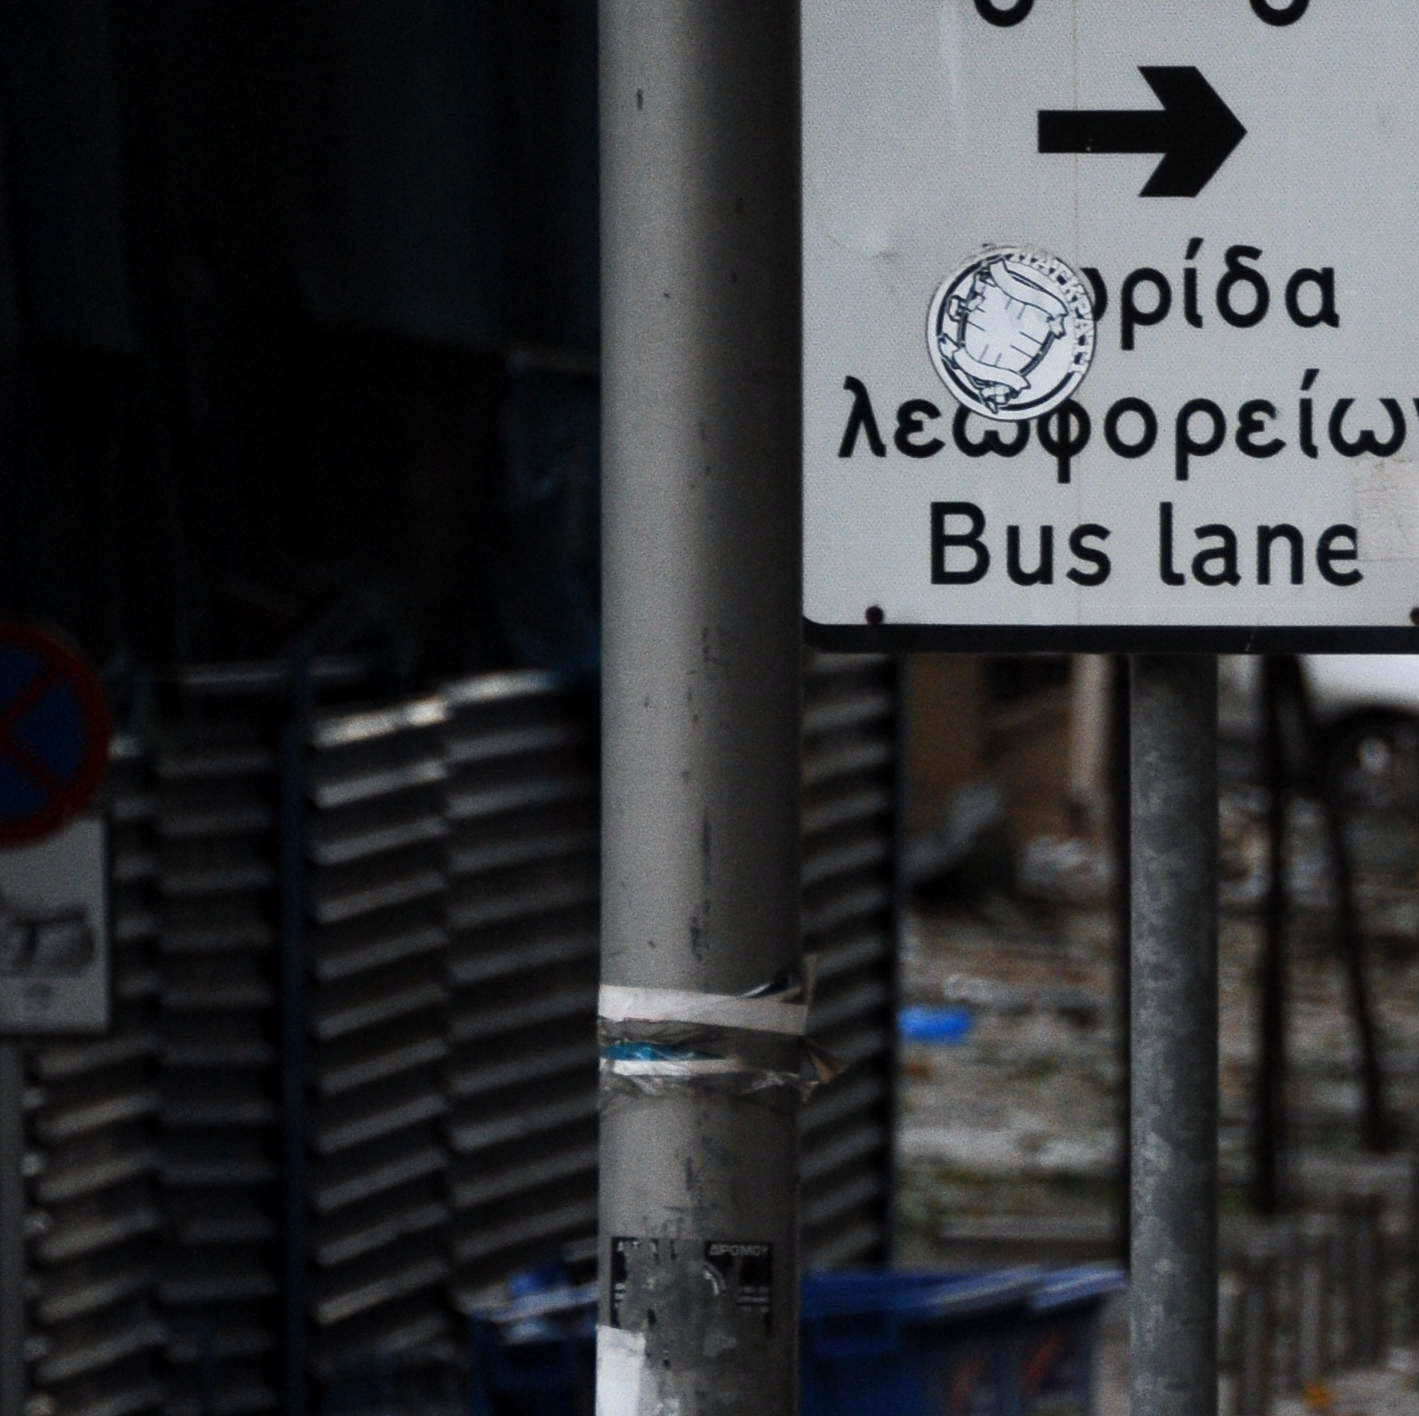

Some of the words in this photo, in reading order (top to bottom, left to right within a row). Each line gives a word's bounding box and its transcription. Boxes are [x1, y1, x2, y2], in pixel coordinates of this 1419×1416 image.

[1086, 238, 1341, 351] ρίδα
[930, 501, 1112, 587] Bus
[1159, 501, 1364, 587] lane
